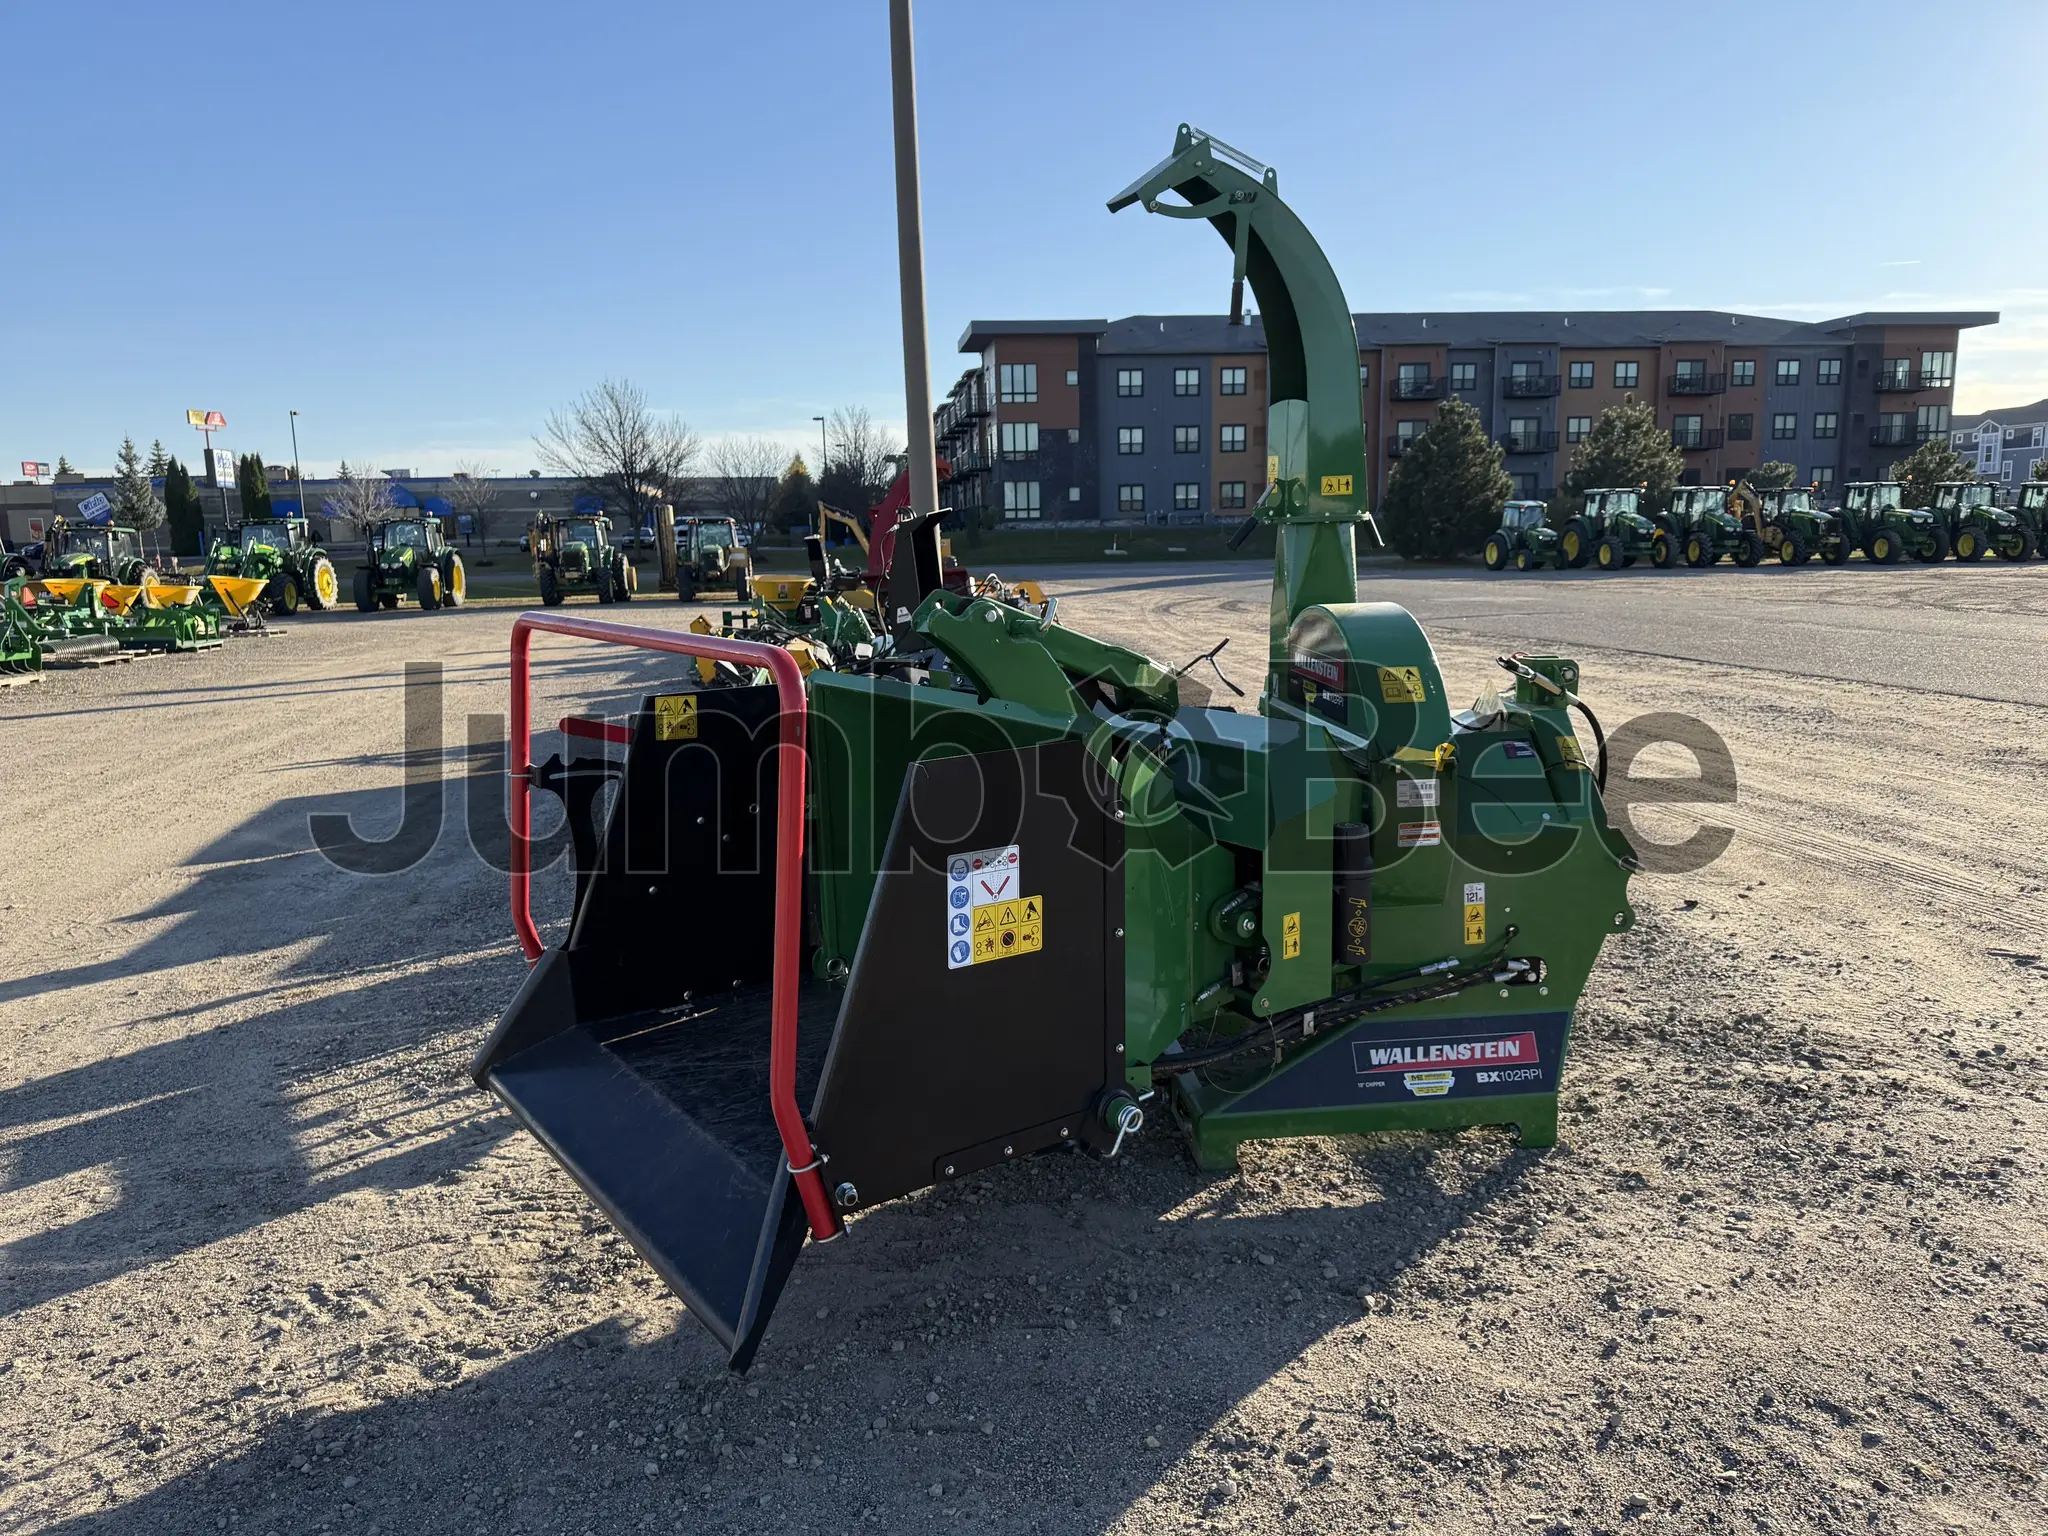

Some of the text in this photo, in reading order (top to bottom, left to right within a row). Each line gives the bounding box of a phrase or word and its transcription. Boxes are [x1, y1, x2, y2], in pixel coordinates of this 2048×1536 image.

[1294, 652, 1339, 681] WALLENSTEIN
[1465, 892, 1478, 903] 121
[1369, 1040, 1520, 1066] WALLENSTEIN
[1476, 1068, 1543, 1083] BX102RPI
